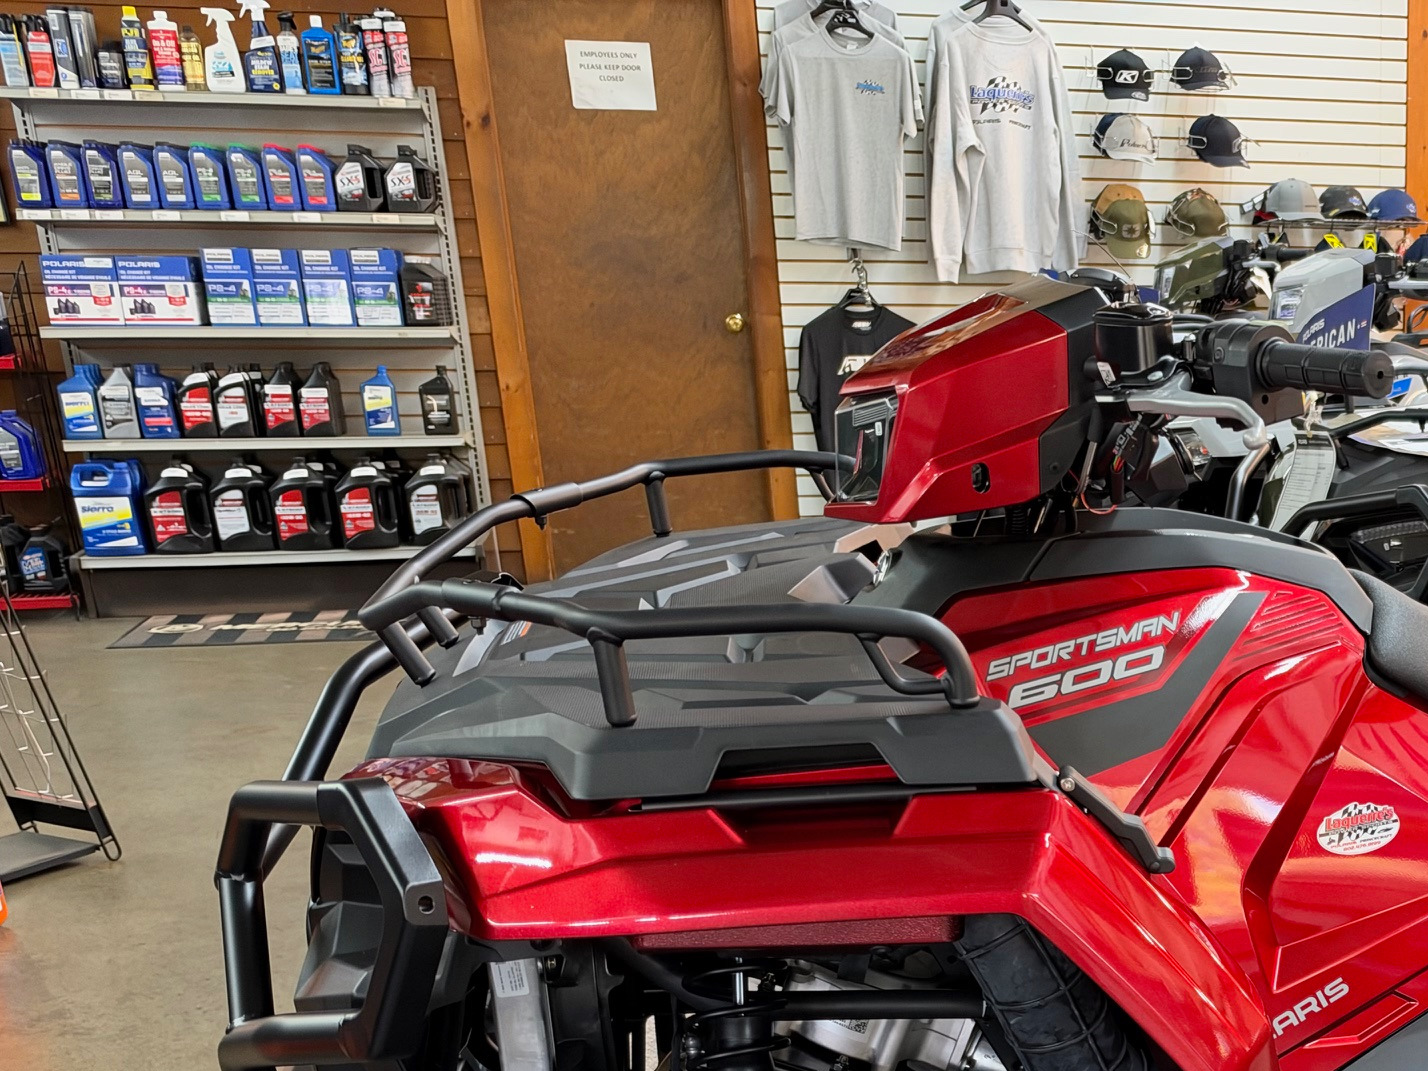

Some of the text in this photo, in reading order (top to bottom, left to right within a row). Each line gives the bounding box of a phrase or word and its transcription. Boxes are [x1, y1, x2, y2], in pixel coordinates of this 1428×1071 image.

[1311, 318, 1356, 348] ERICAN
[985, 611, 1181, 682] SPORTSMAN
[1007, 643, 1166, 710] 600
[1325, 806, 1394, 833] Laquerre's
[1271, 976, 1350, 1040] ARIS
